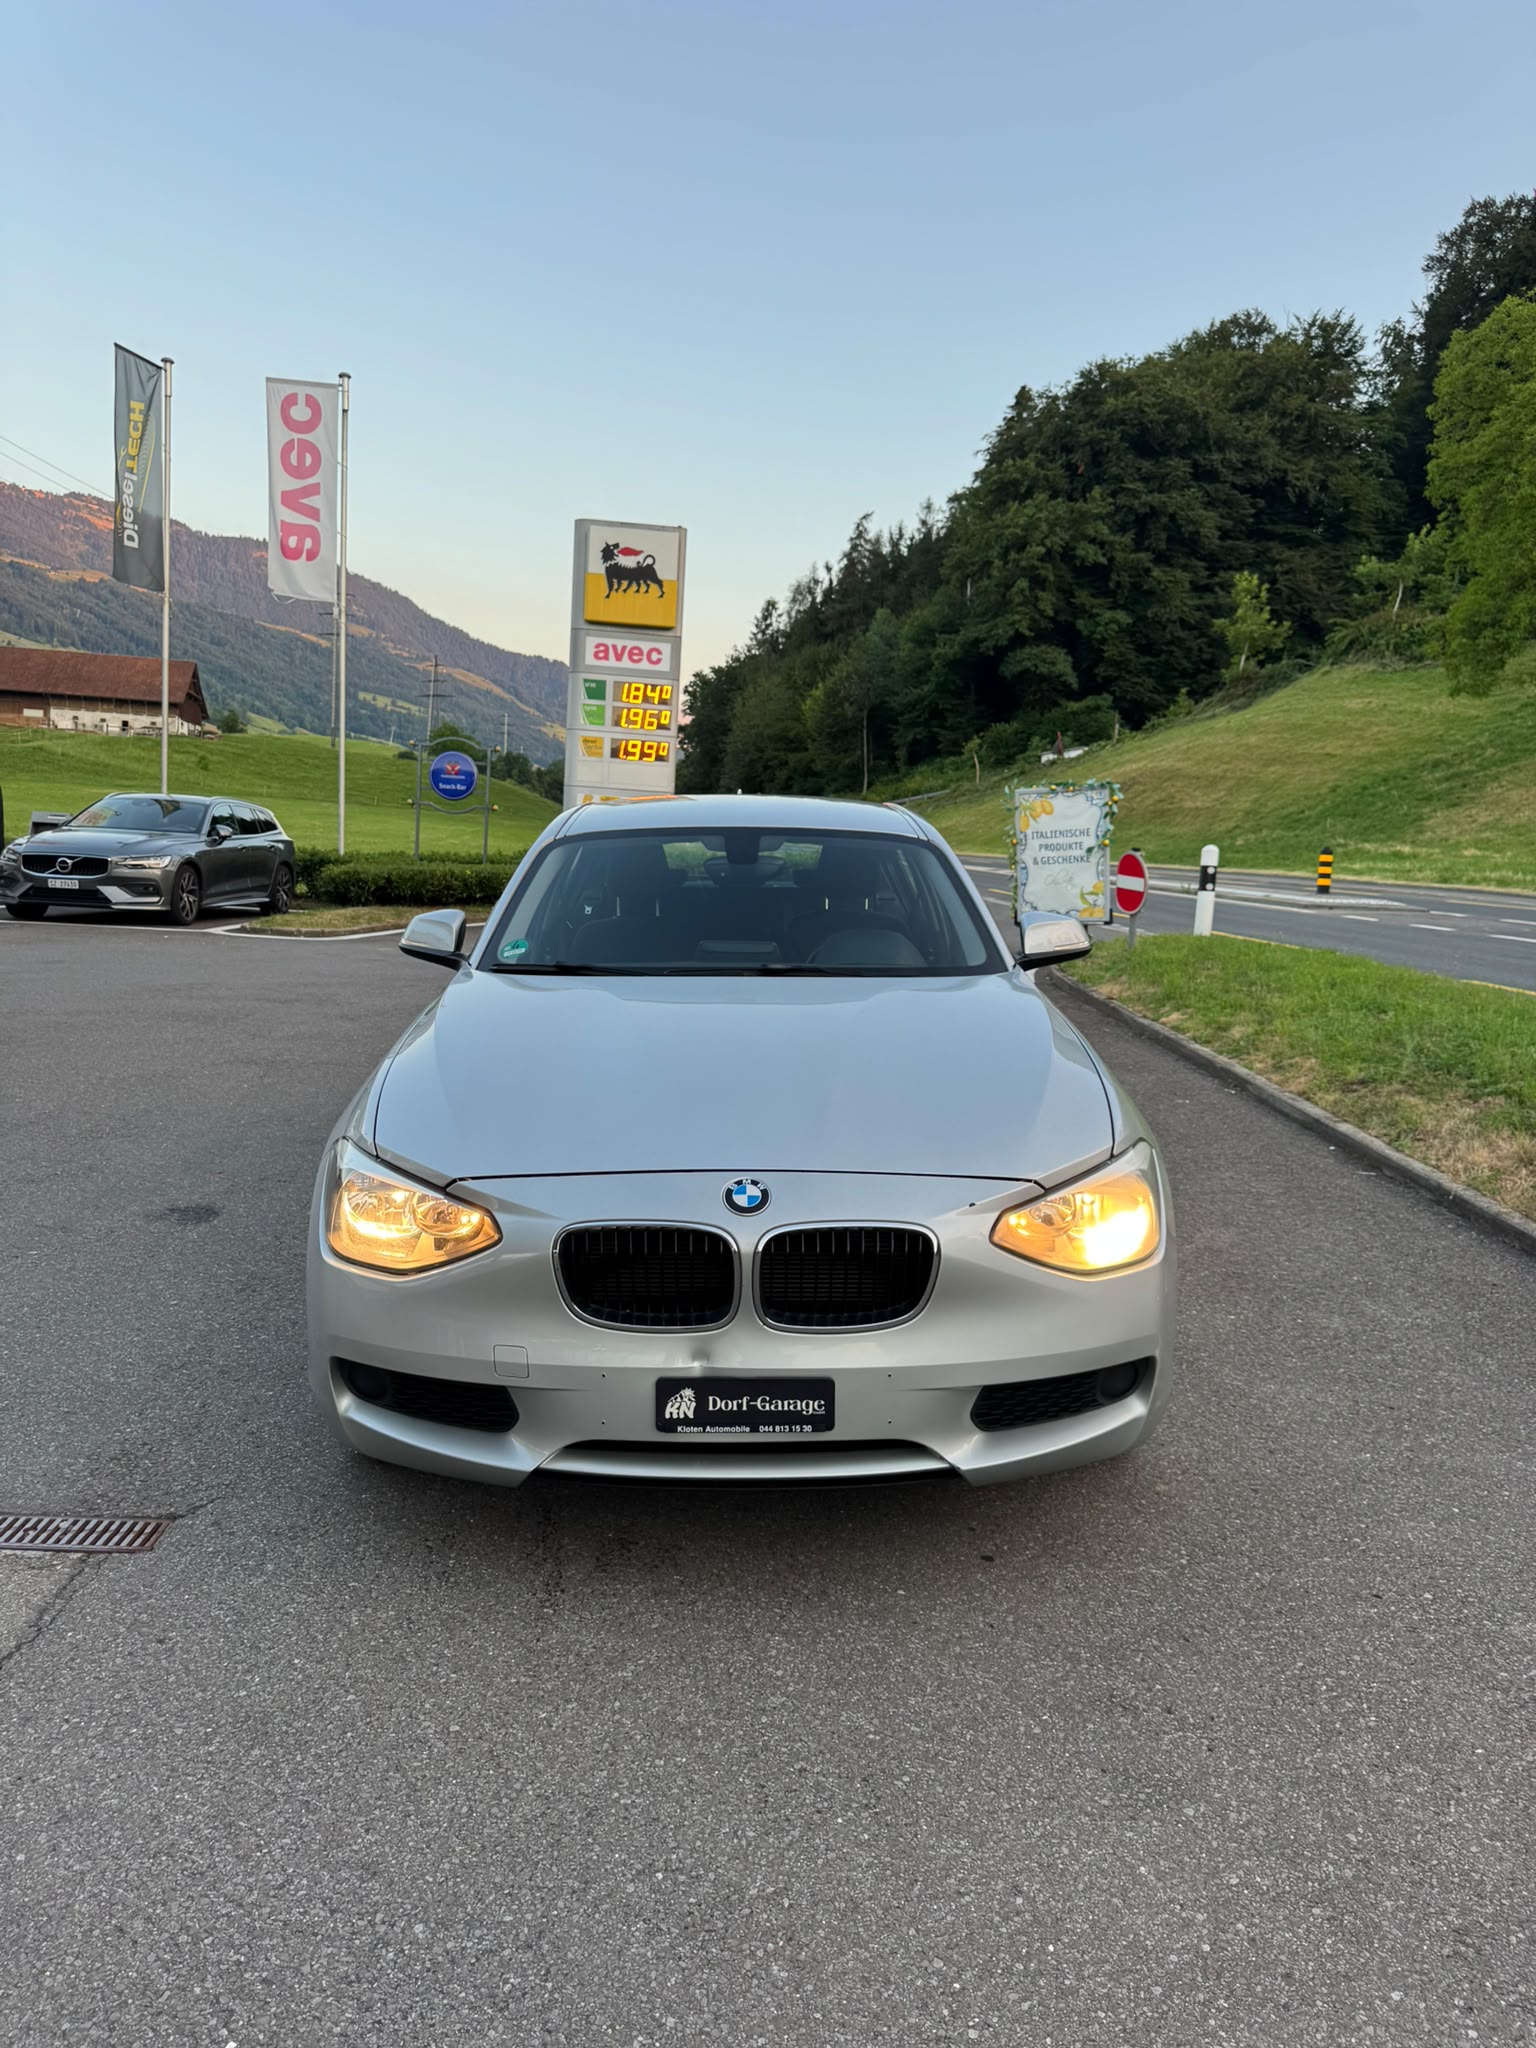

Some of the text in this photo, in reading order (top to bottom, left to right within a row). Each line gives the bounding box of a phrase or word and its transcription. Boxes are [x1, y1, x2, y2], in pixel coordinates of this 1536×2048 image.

[123, 400, 145, 549] DieselTECH
[279, 391, 323, 563] avec
[592, 641, 664, 666] avec
[1031, 828, 1091, 840] ITALIENISCHE
[1039, 842, 1084, 852] PRODUKTE
[1032, 855, 1091, 865] & GESCHENKE
[707, 1395, 826, 1416] Dorf-Garage
[677, 1425, 813, 1433] Kloten Automobile 044 813 15 30
